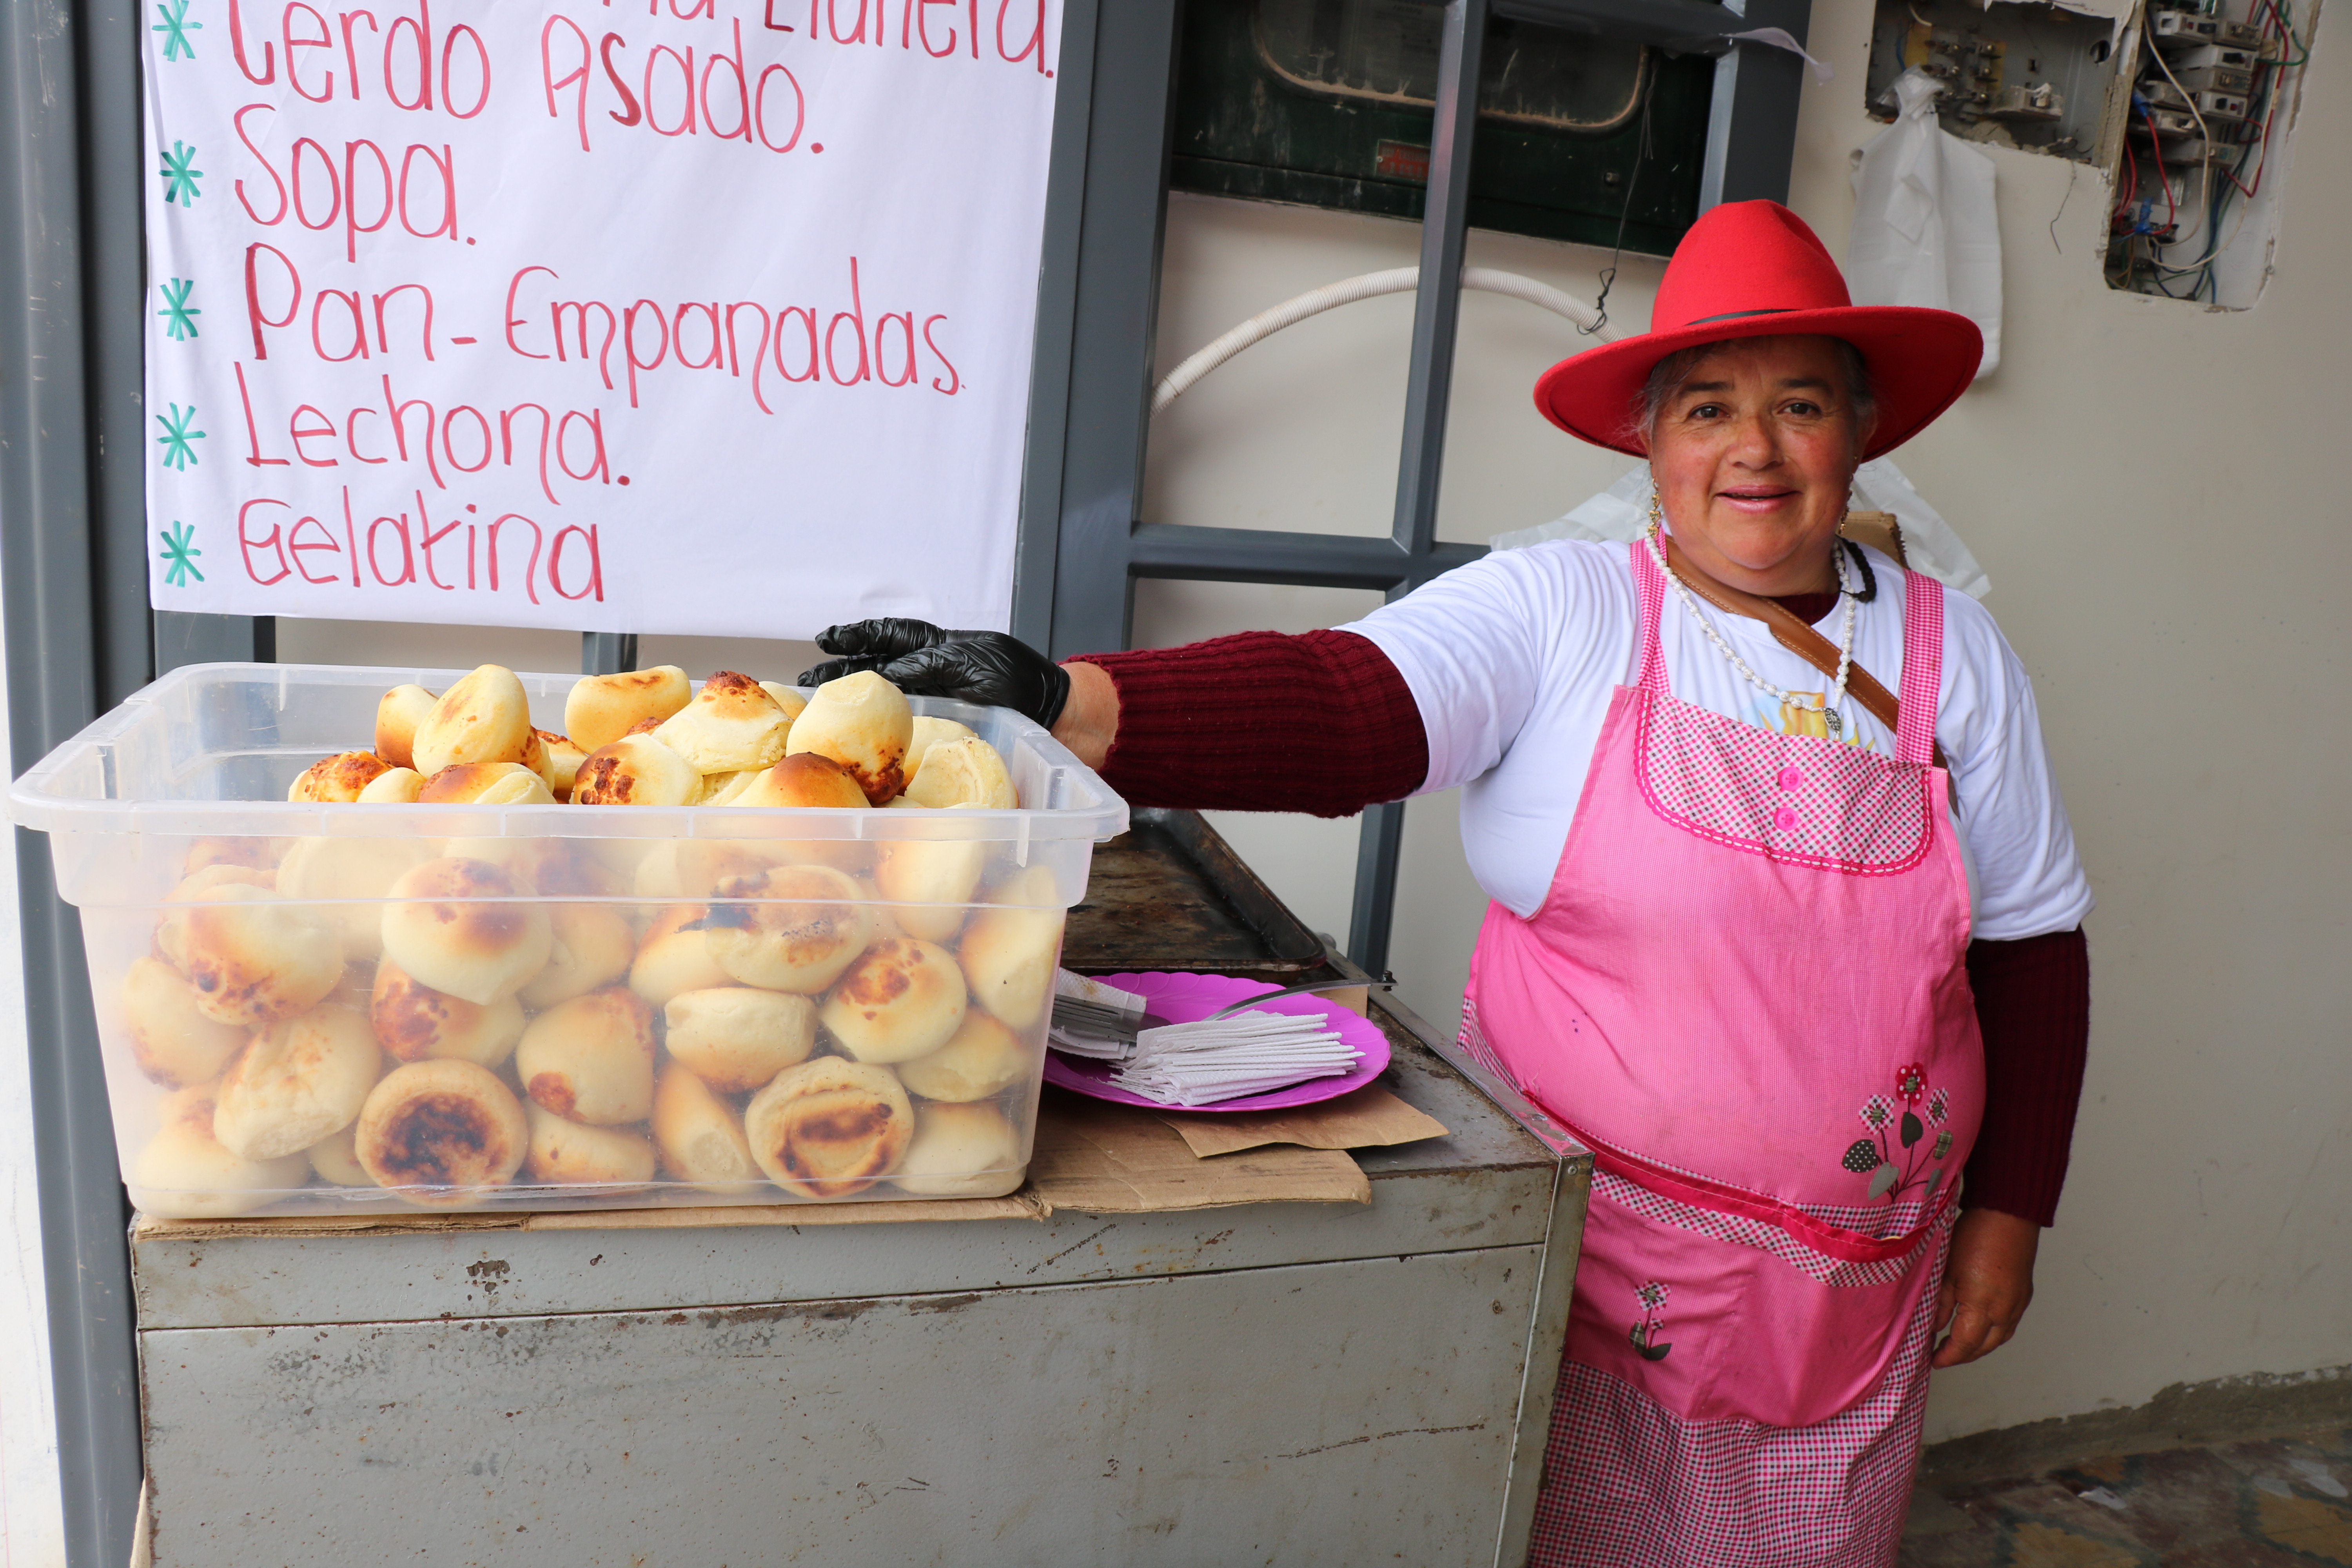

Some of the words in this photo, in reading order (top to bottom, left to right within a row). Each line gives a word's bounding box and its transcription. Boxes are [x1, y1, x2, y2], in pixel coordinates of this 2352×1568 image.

[229, 0, 491, 119] Cerdo
[541, 14, 824, 154] Asado.
[233, 103, 476, 263] Sopa.
[234, 361, 630, 505] Lechona.
[238, 486, 604, 605] Gelatina
